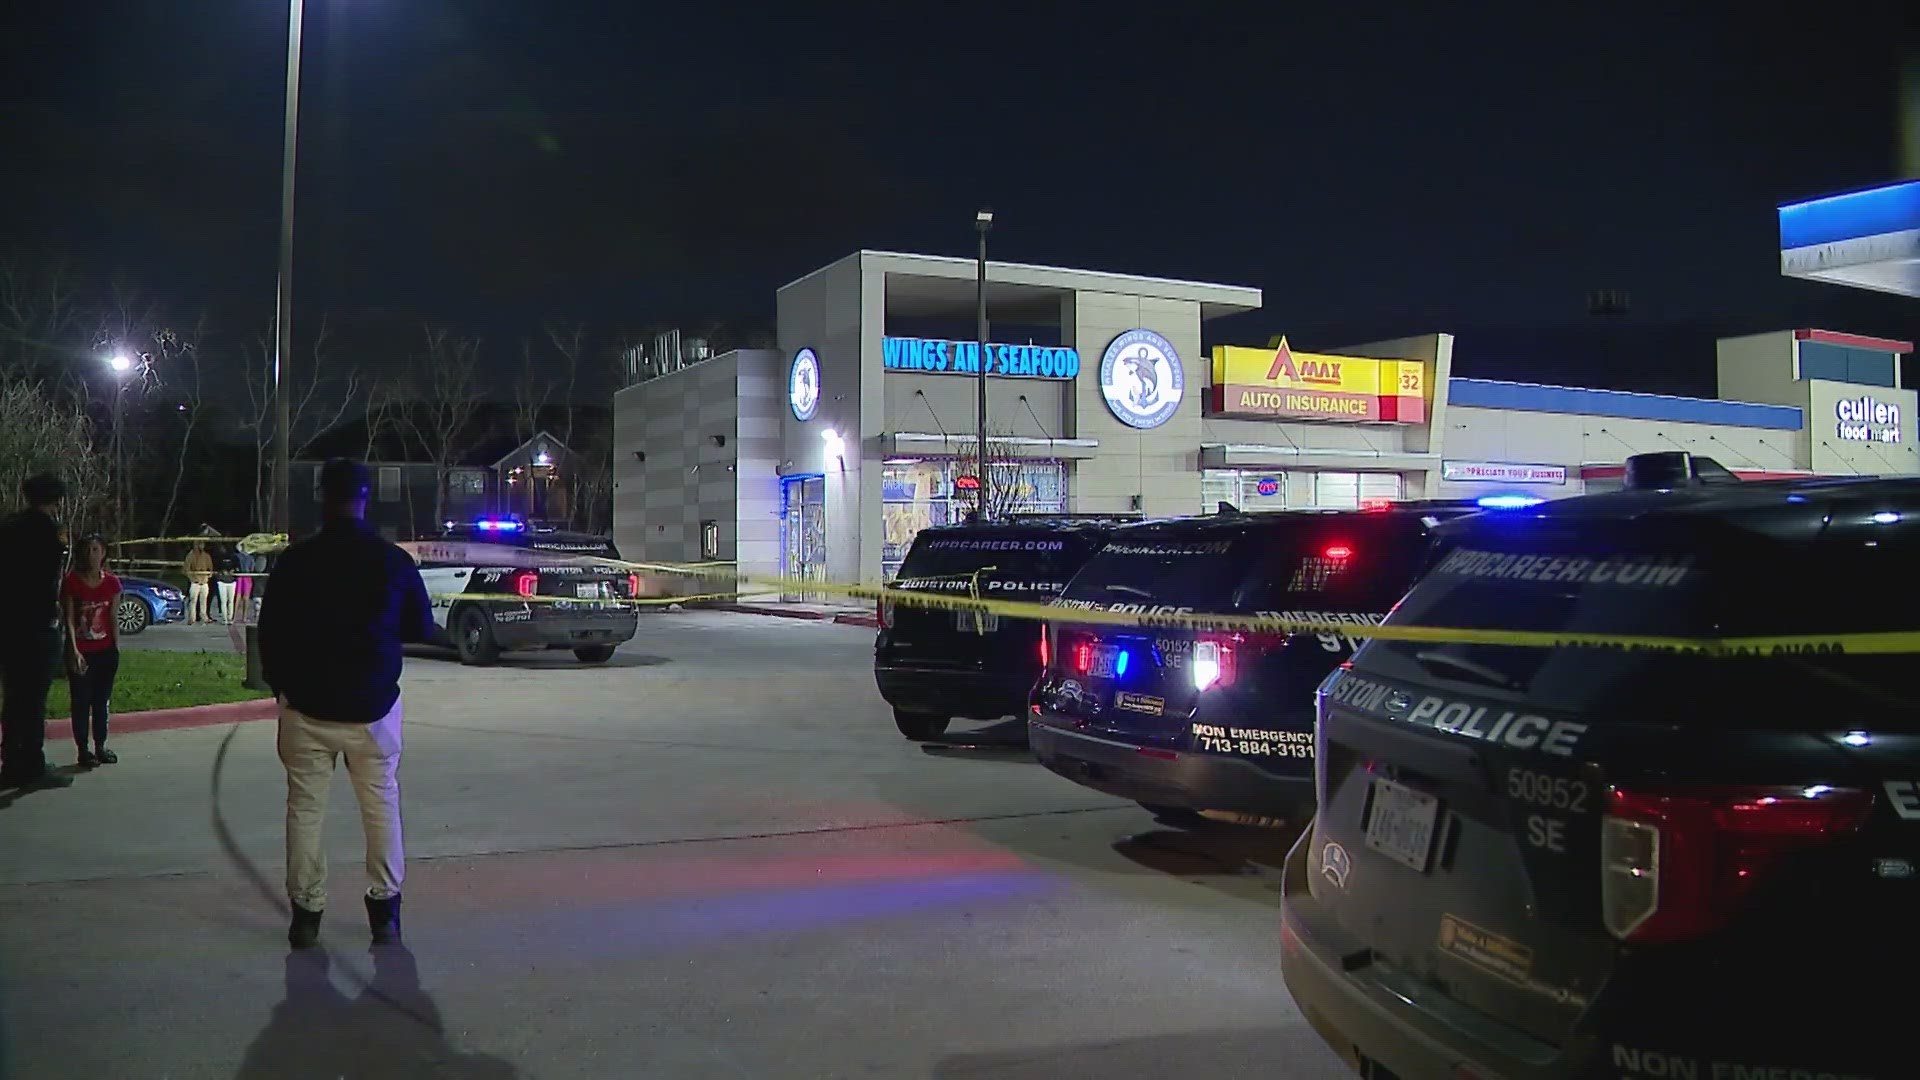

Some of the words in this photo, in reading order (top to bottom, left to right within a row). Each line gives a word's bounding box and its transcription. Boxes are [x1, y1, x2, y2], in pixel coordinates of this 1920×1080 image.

[883, 337, 948, 372] WINGS
[999, 345, 1080, 379] SEAFOOD
[1240, 391, 1281, 409] AUTO
[1286, 394, 1367, 416] INSURANCE
[1837, 397, 1900, 425] cullen
[1838, 421, 1869, 441] food
[1871, 427, 1901, 443] mart
[987, 580, 1065, 591] POLICE
[1165, 653, 1182, 668] SE
[1192, 722, 1225, 738] NON
[1230, 727, 1315, 744] EMERGENCY
[1407, 695, 1589, 757] POLICE
[1200, 736, 1316, 759] 713-884-3131
[1508, 768, 1588, 813] 50952
[1882, 780, 1920, 819] E
[1528, 815, 1566, 852] SE
